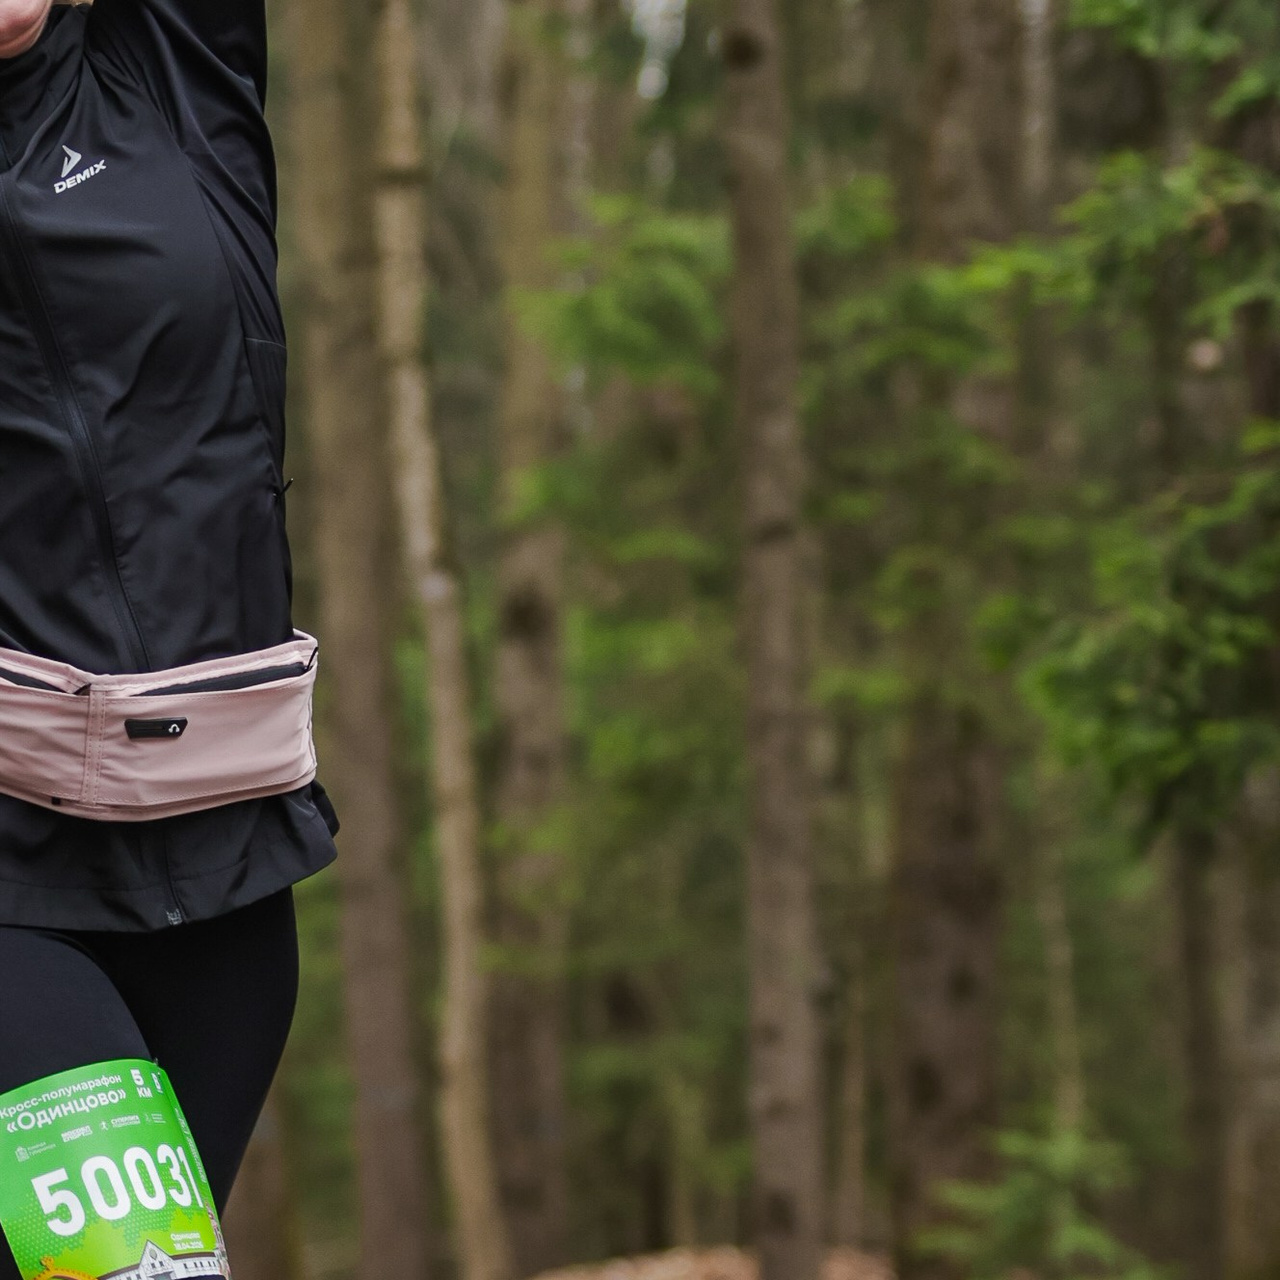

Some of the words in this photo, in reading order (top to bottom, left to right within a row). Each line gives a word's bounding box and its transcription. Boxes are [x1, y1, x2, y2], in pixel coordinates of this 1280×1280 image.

[53, 159, 107, 194] DEMIX
[130, 1068, 145, 1086] 5
[31, 1143, 204, 1237] 50031
